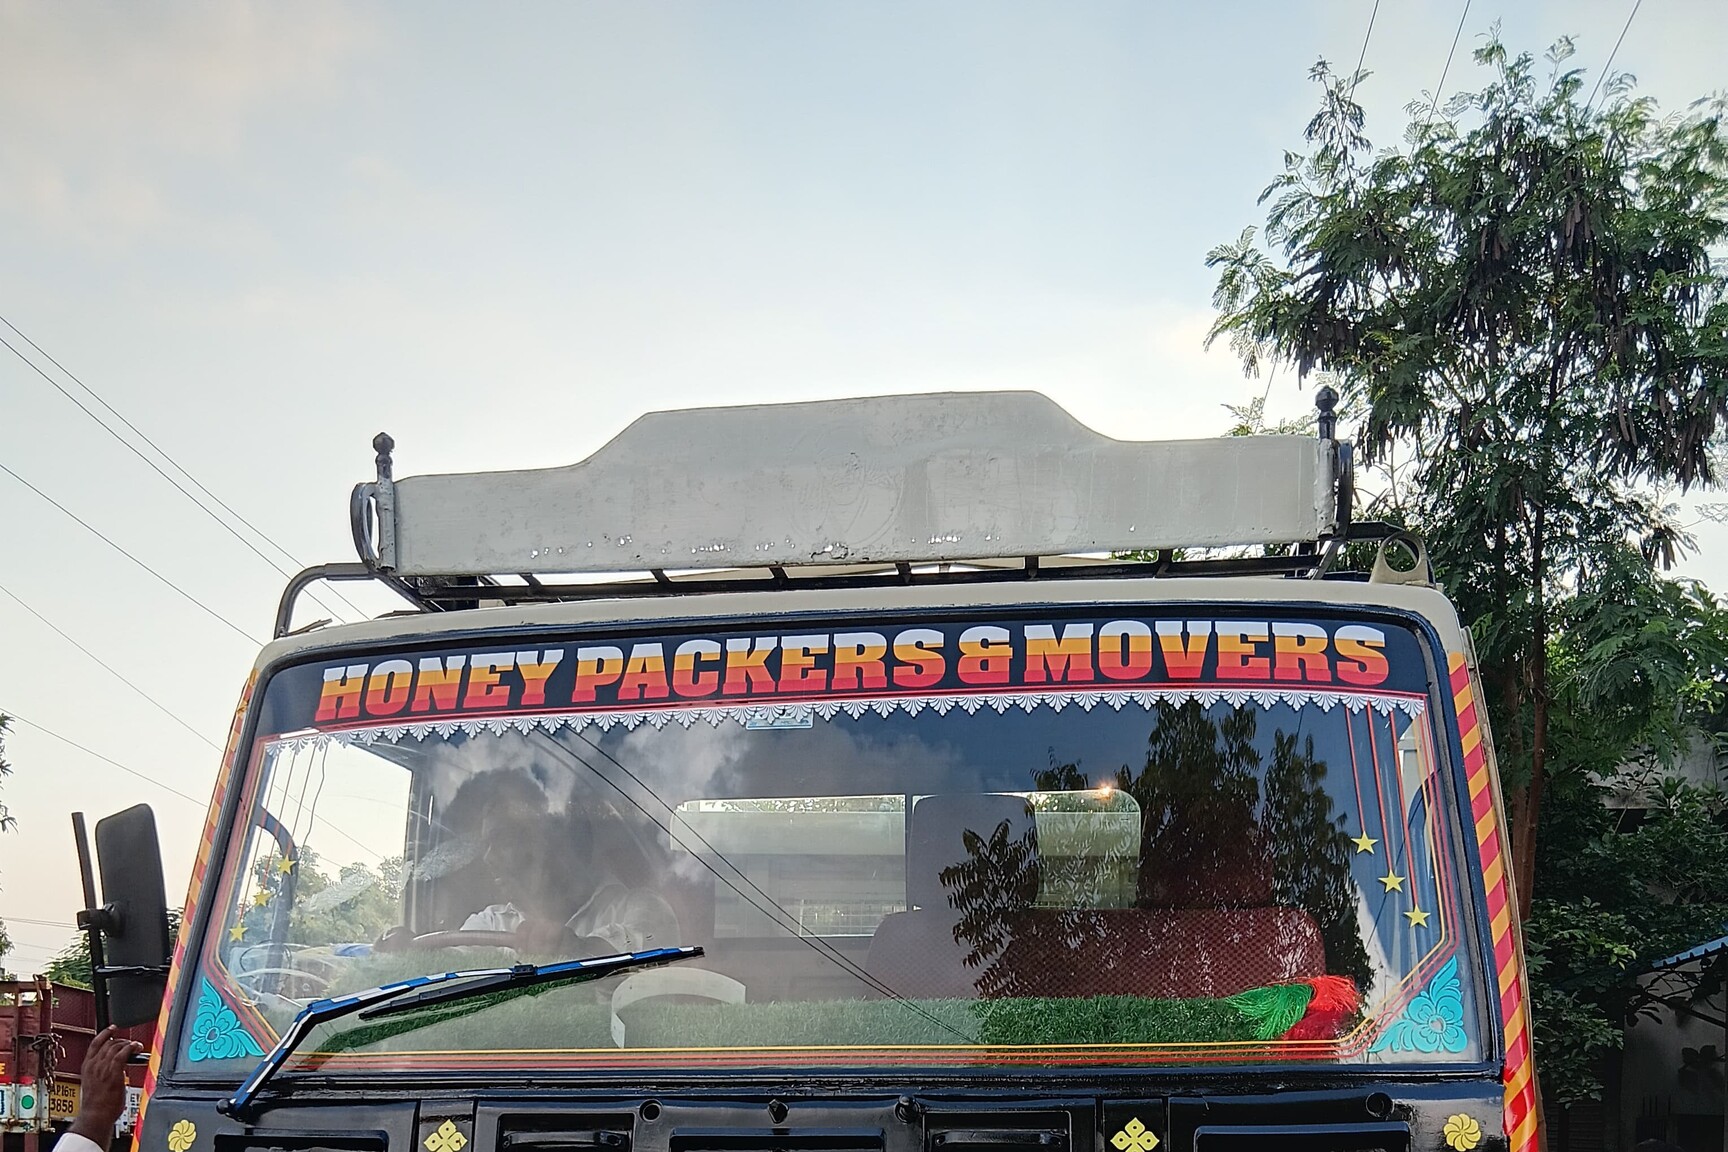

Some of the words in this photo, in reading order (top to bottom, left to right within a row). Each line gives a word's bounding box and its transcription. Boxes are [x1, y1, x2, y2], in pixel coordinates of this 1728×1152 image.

[315, 648, 565, 722] HONEY
[571, 627, 946, 703] PACKERS
[957, 625, 1014, 685] &
[1023, 619, 1390, 686] MOVERS
